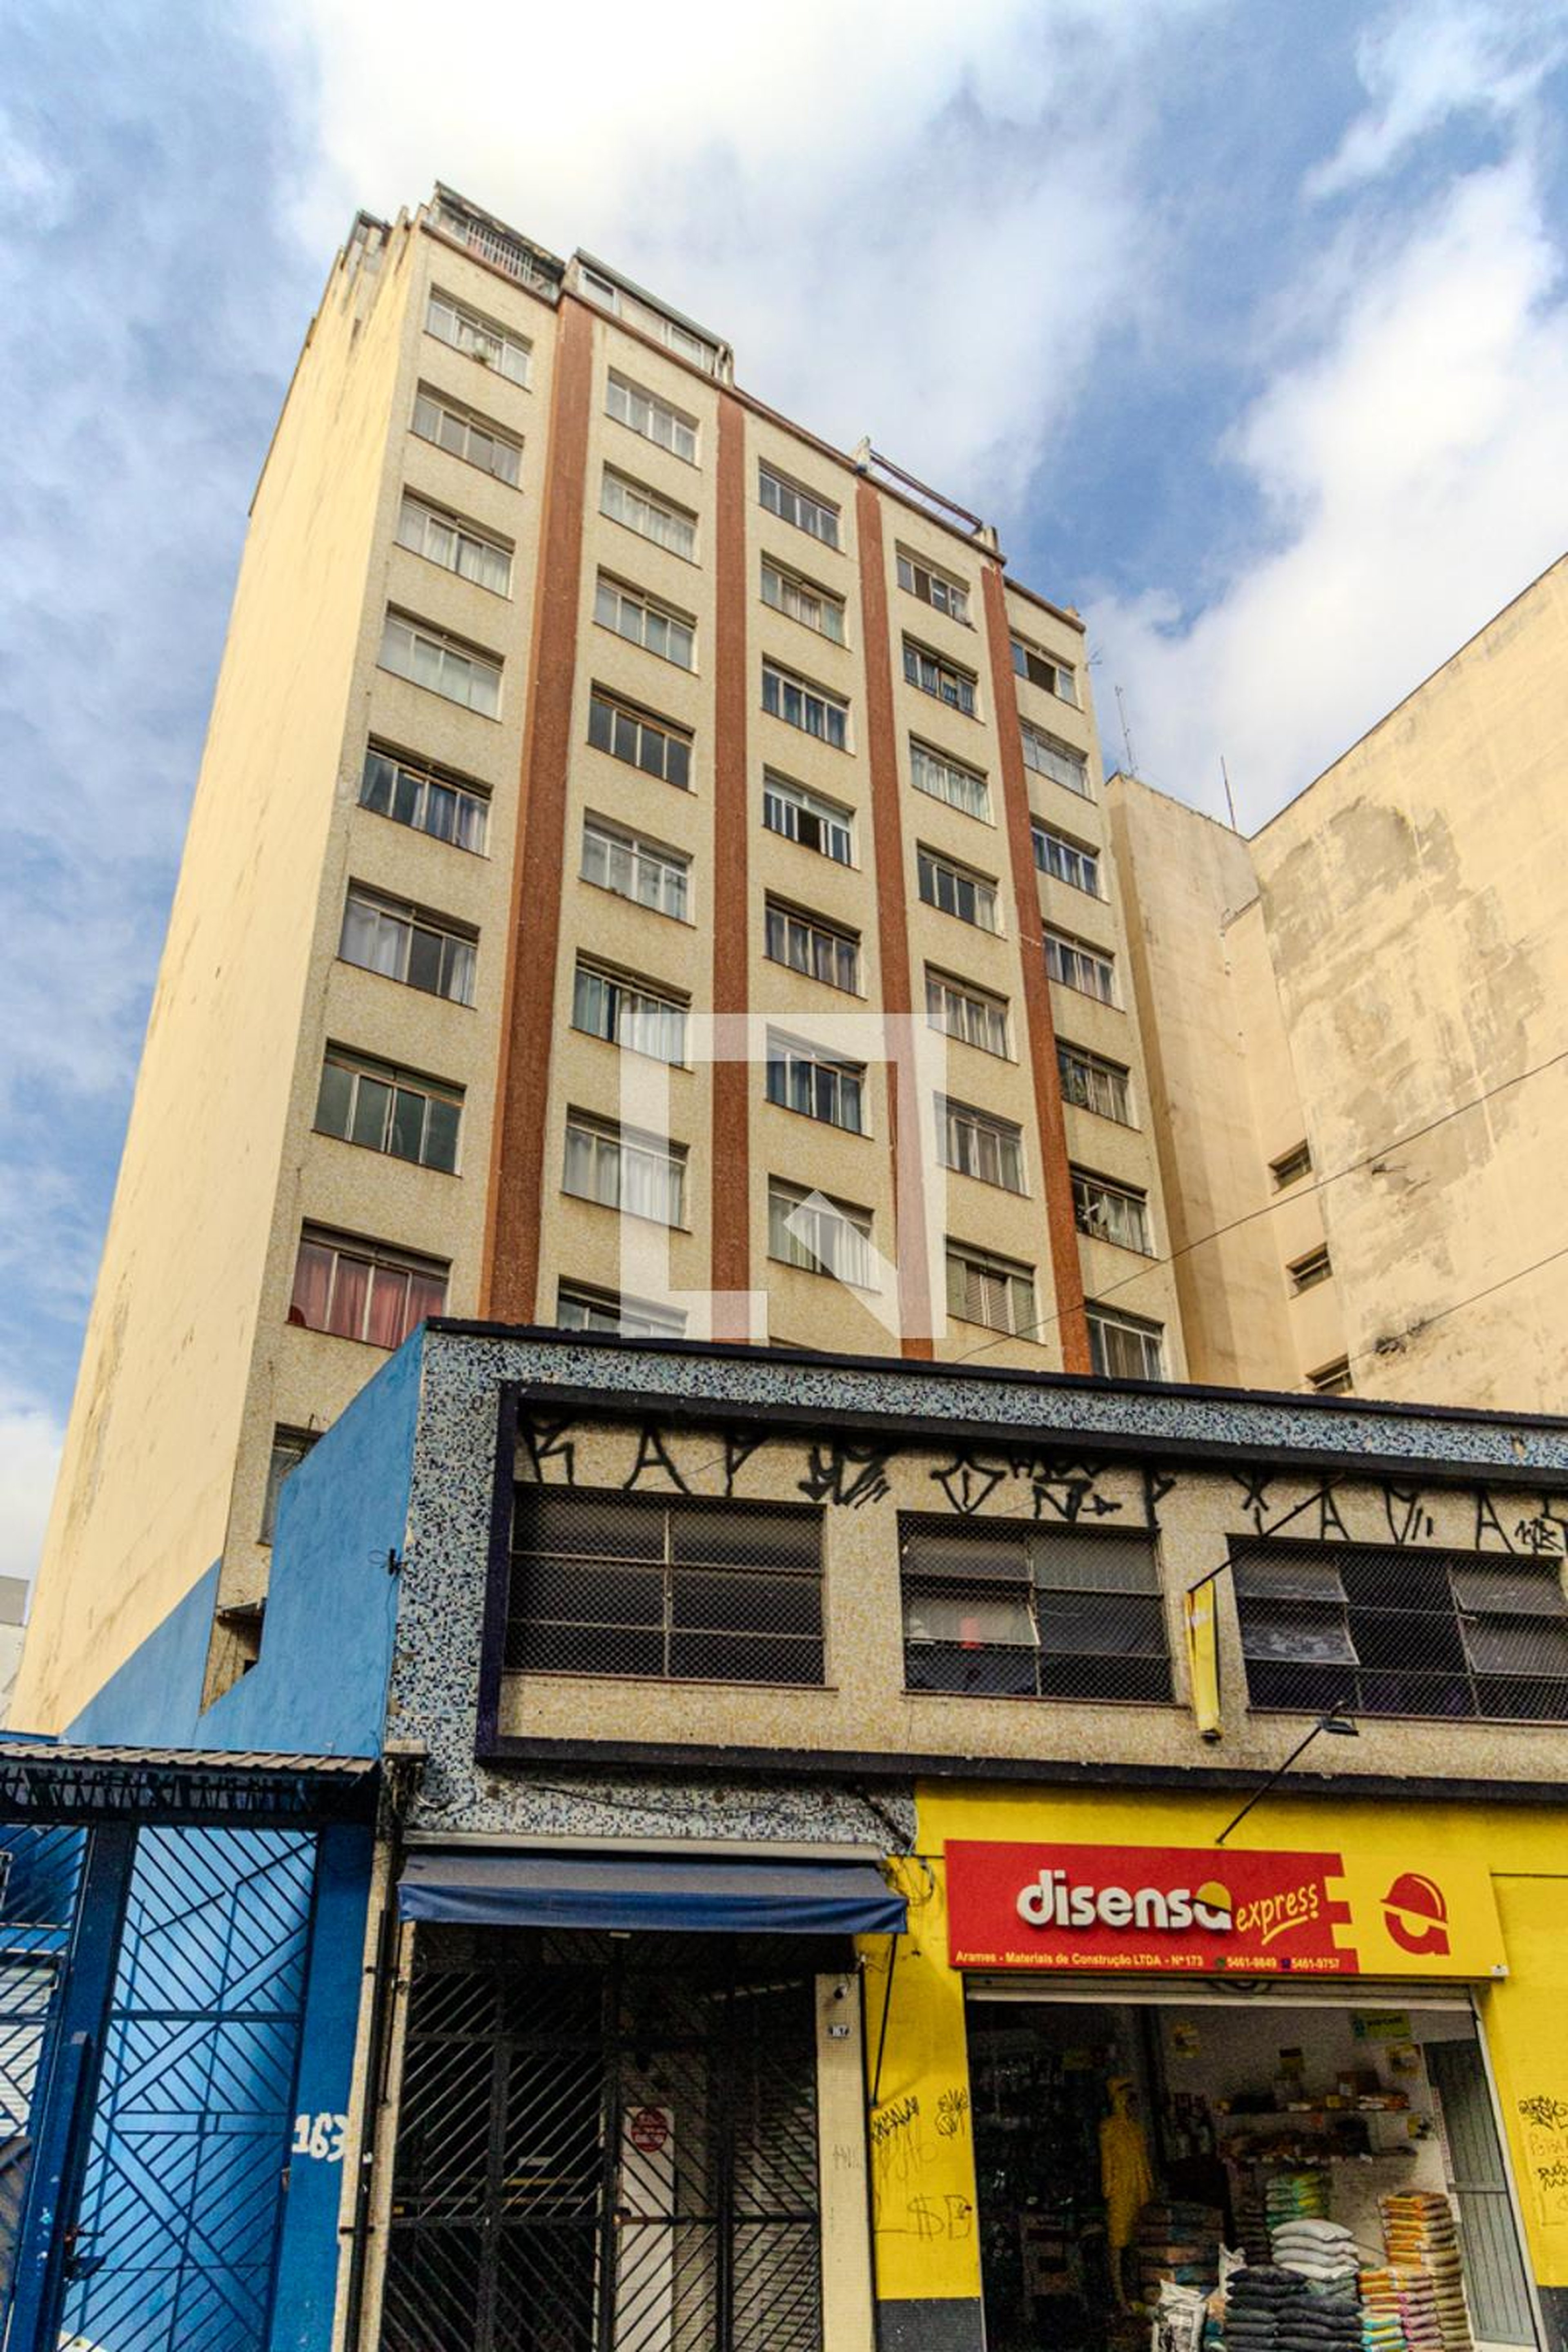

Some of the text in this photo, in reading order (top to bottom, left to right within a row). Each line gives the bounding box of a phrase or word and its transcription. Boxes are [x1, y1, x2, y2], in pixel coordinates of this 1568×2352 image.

[1016, 1869, 1319, 1936] disensa express
[956, 1950, 996, 1962] Arames
[1005, 1951, 1053, 1964] Materiais
[1056, 1953, 1069, 1964] de
[1071, 1953, 1131, 1966] Construção
[1133, 1954, 1161, 1966] LTDA
[292, 2113, 348, 2163] 163
